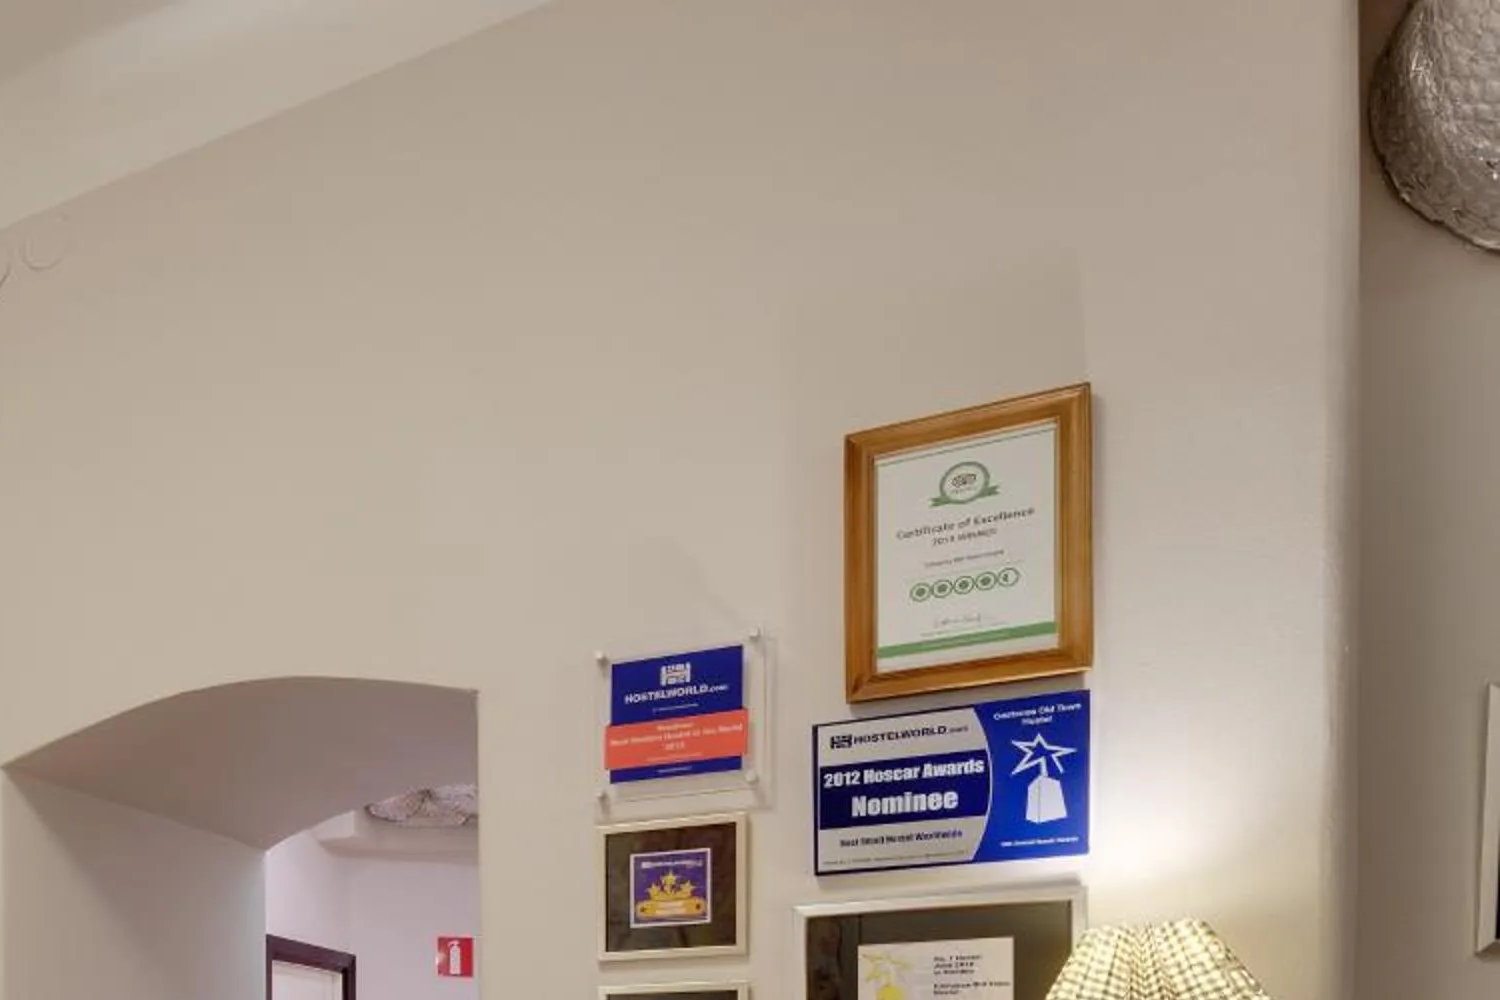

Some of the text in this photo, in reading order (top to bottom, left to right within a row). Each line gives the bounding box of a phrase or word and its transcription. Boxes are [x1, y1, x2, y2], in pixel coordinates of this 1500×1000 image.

[823, 758, 985, 789] 2012 Hoscar Awards
[851, 791, 960, 818] Nominee
